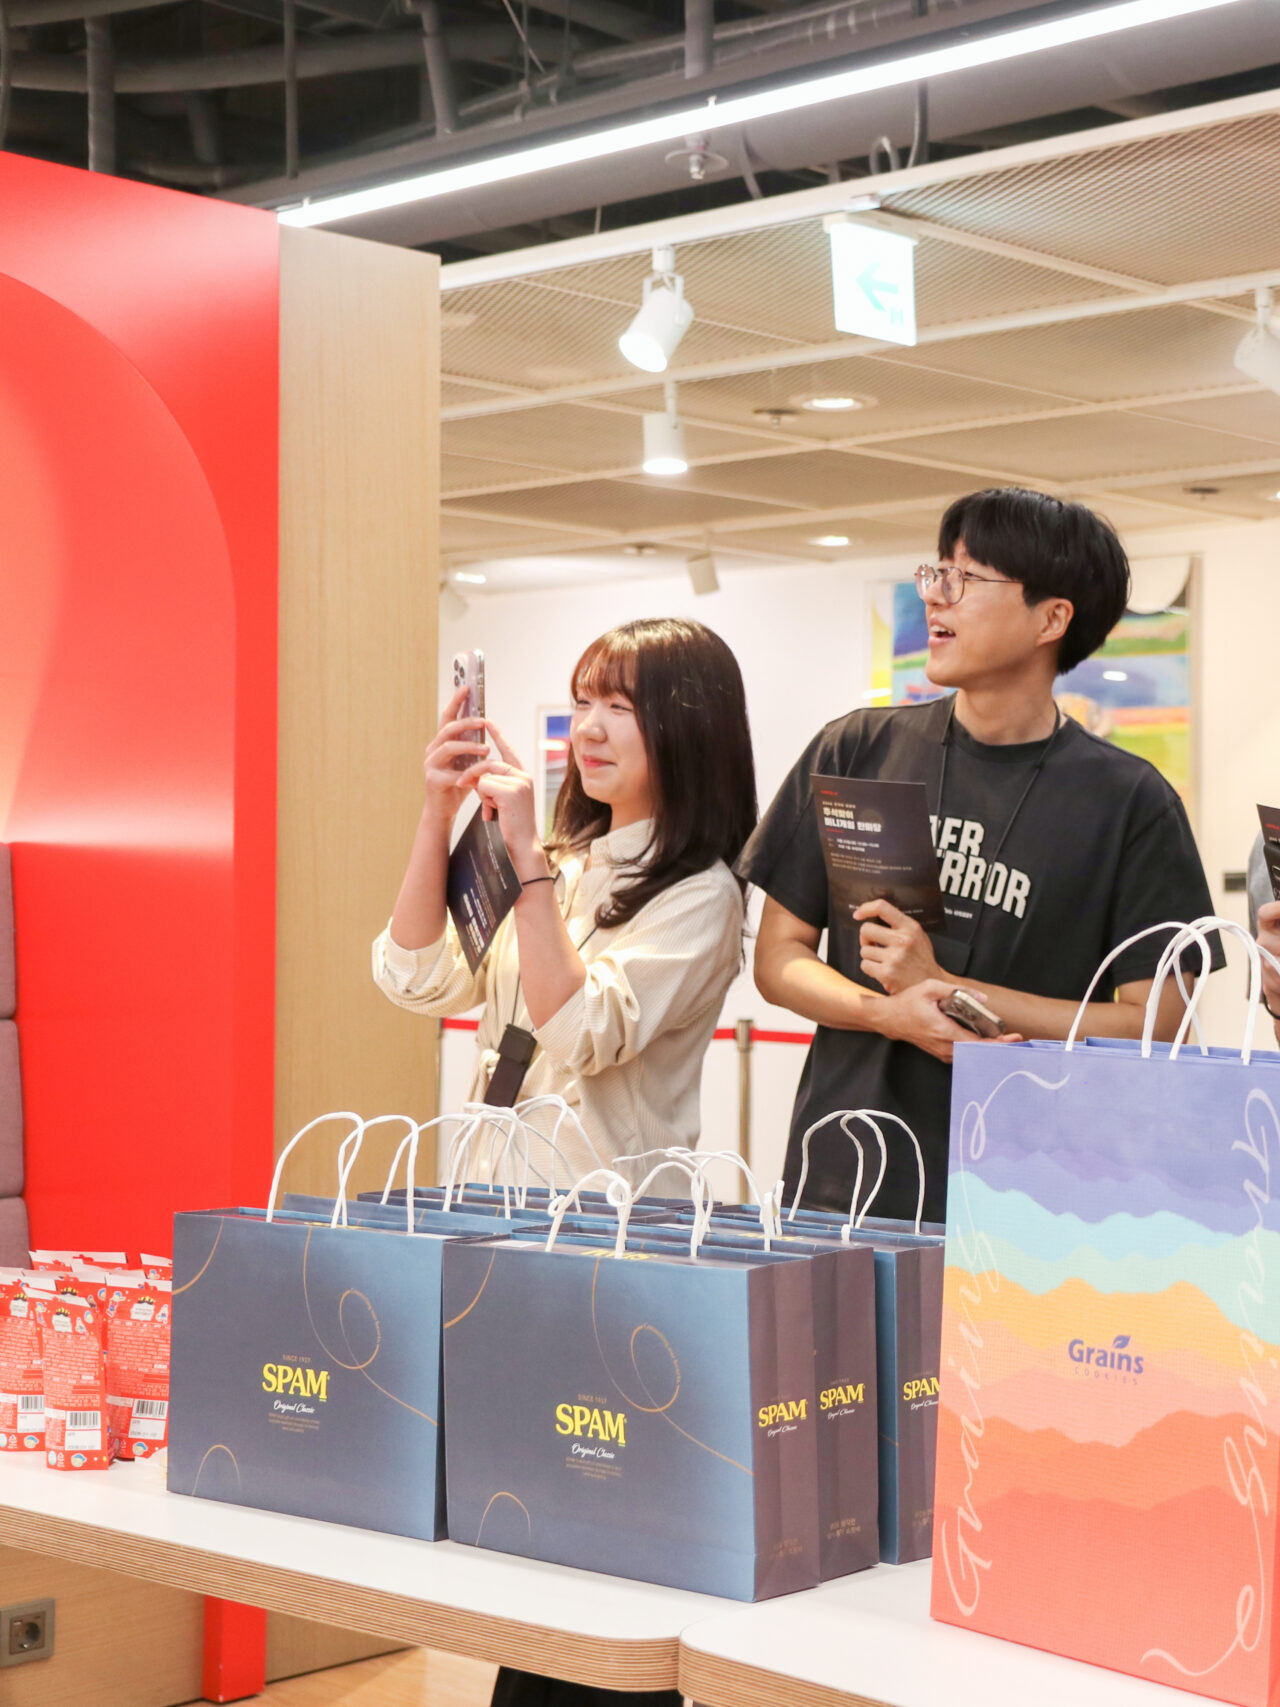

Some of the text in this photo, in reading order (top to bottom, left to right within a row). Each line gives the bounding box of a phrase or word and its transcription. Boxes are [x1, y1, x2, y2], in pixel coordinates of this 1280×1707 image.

[936, 848, 1032, 919] RROR
[1068, 1335, 1144, 1374] Grains
[262, 1363, 329, 1400] SPAM
[820, 1383, 864, 1410] SPAM
[555, 1403, 626, 1445] SPAM
[758, 1398, 807, 1428] SPAM
